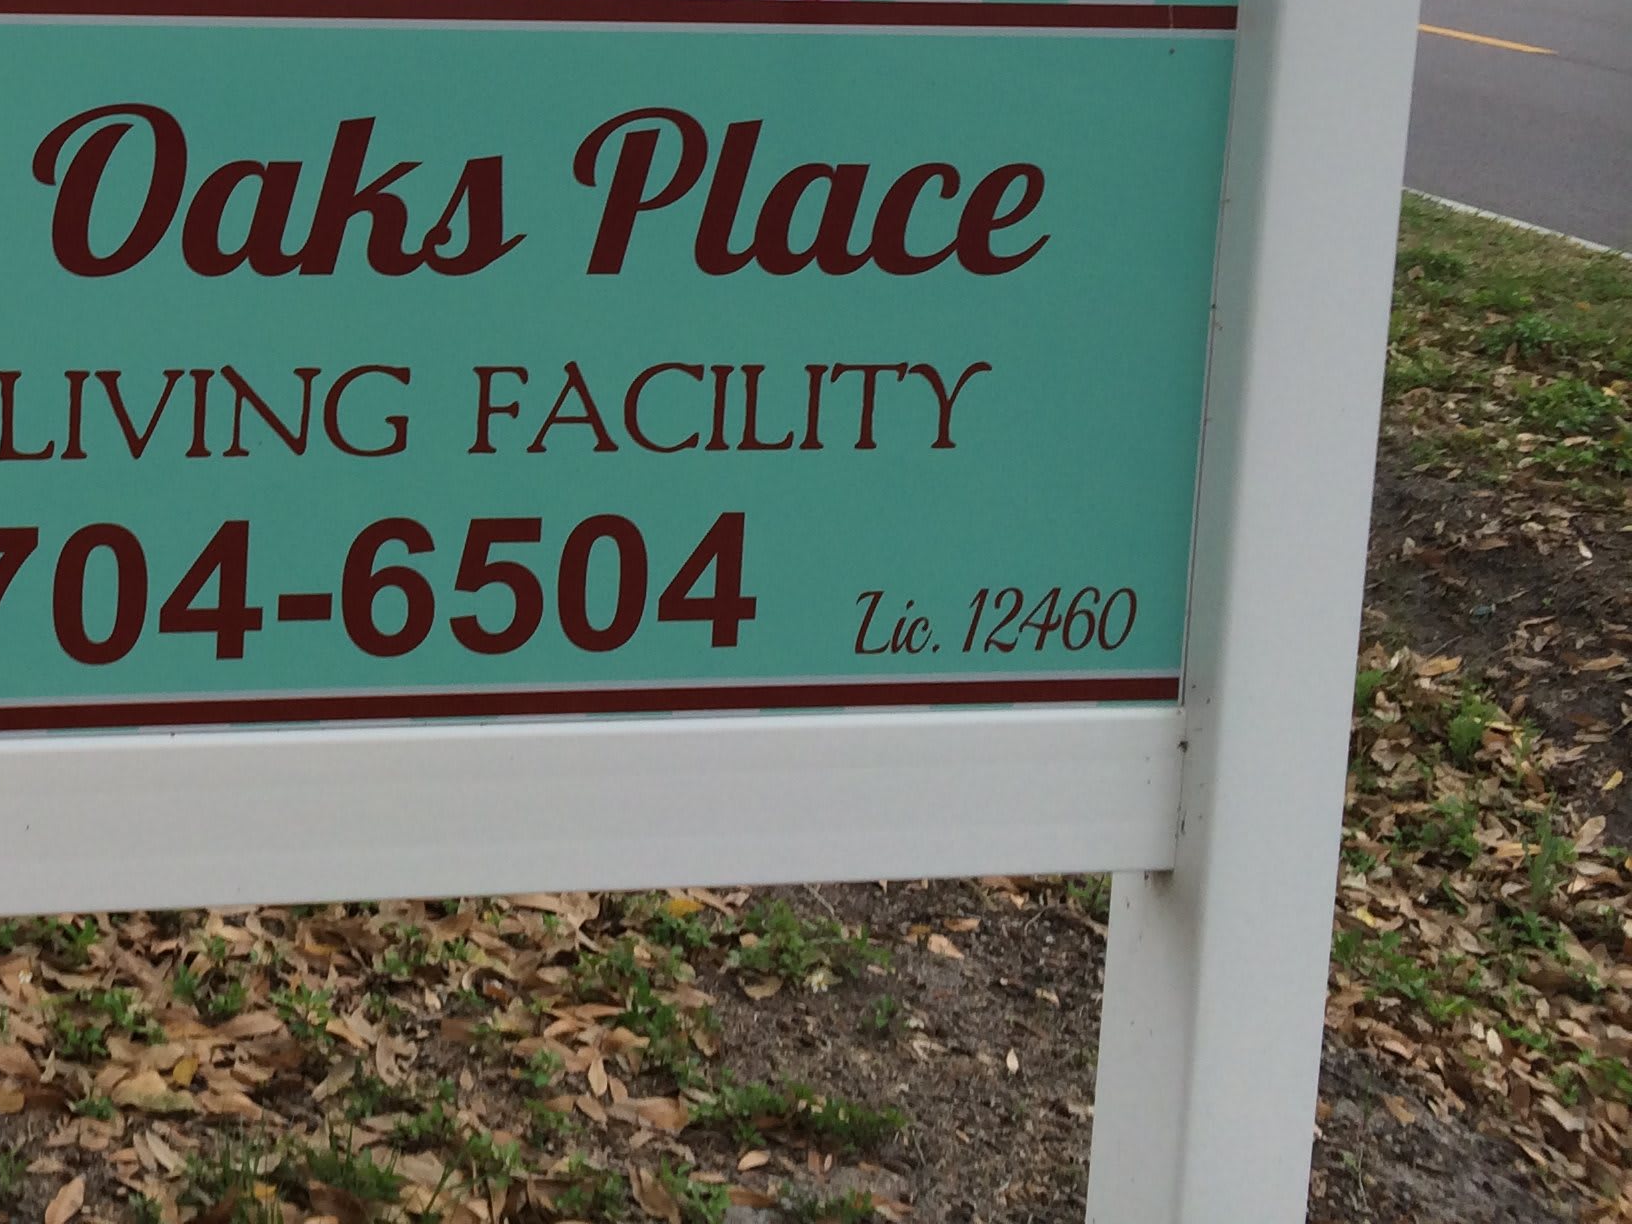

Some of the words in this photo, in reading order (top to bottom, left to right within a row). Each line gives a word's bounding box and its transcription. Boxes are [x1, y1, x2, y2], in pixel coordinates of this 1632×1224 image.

[32, 103, 524, 278] Oaks
[573, 107, 1049, 276] Place
[471, 362, 991, 454] FACILITY
[854, 590, 941, 655] Lic.
[962, 587, 1138, 653] 12460
